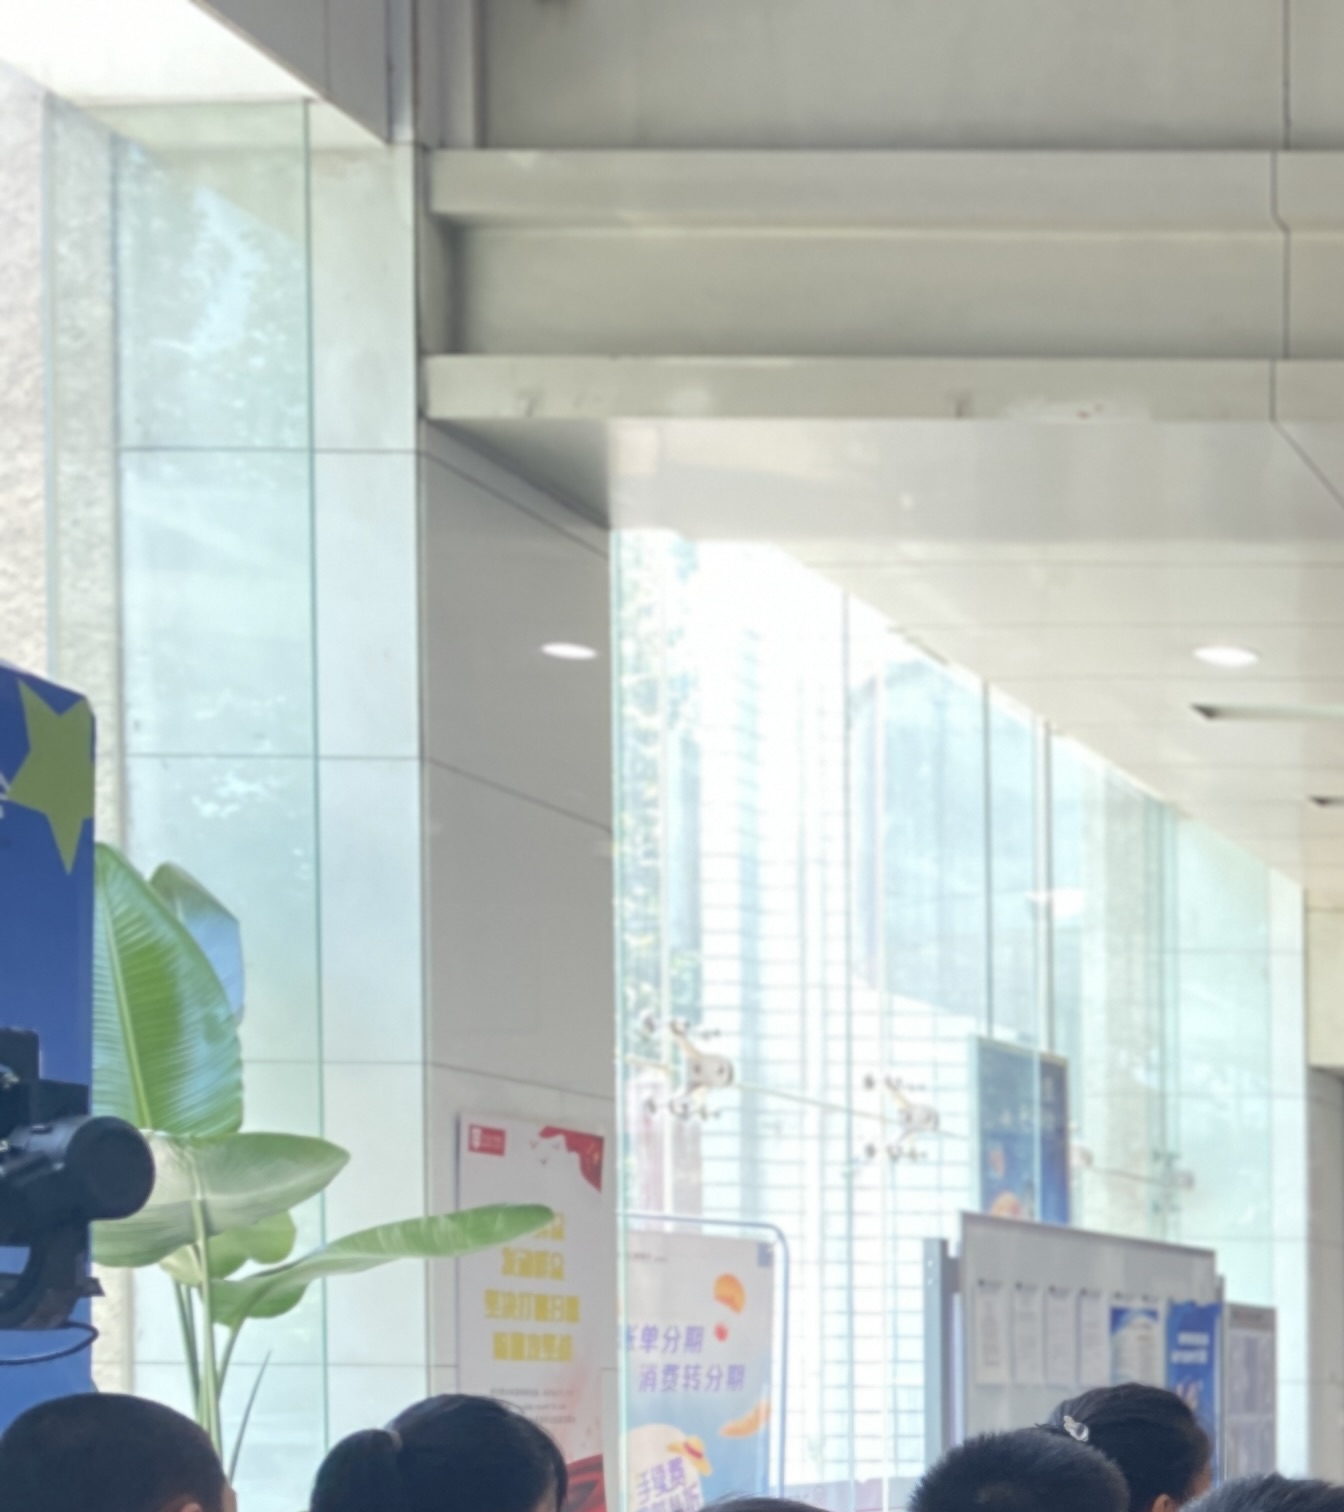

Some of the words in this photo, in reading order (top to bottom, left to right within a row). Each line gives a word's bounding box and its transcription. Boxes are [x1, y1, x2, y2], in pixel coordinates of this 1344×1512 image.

[638, 1363, 746, 1393] 消费转分期
